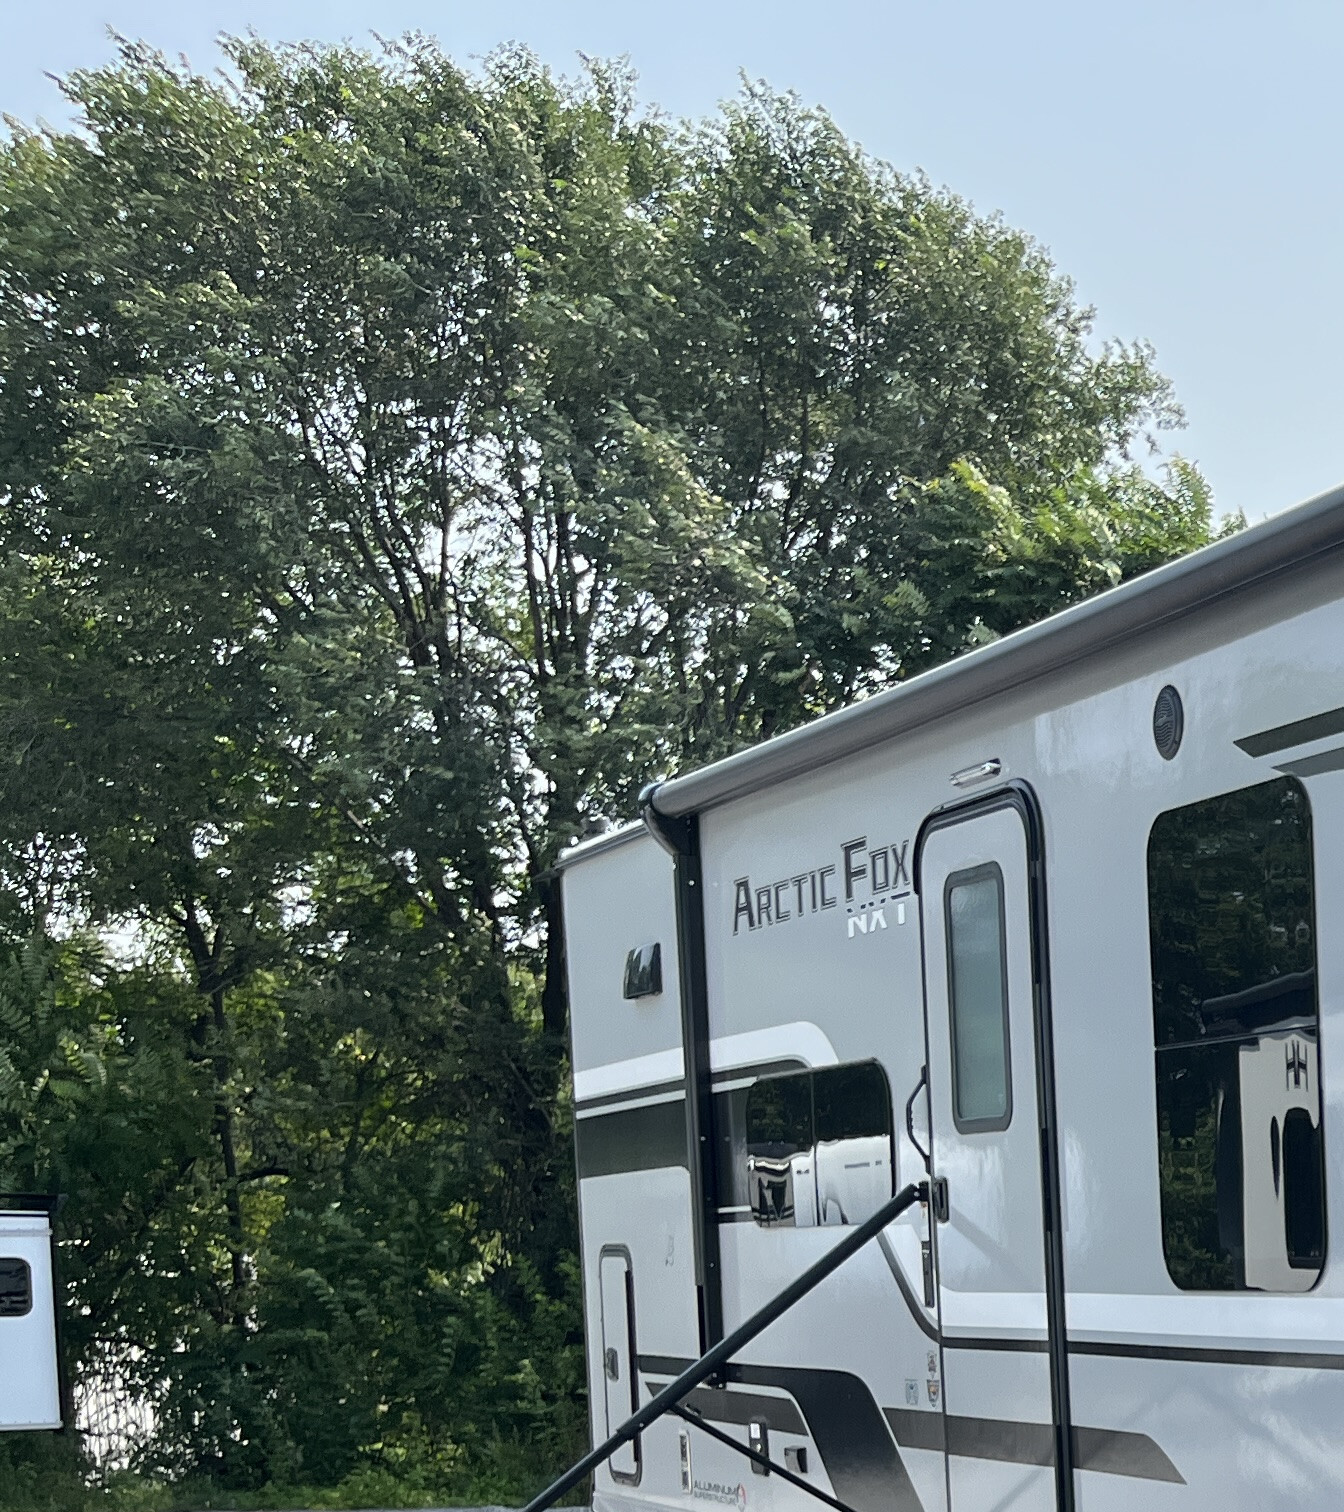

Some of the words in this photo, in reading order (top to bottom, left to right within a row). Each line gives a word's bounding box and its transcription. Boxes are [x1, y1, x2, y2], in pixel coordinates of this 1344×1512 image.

[733, 864, 837, 936] ARCTIC
[840, 836, 910, 904] FOX
[846, 891, 911, 938] NXT
